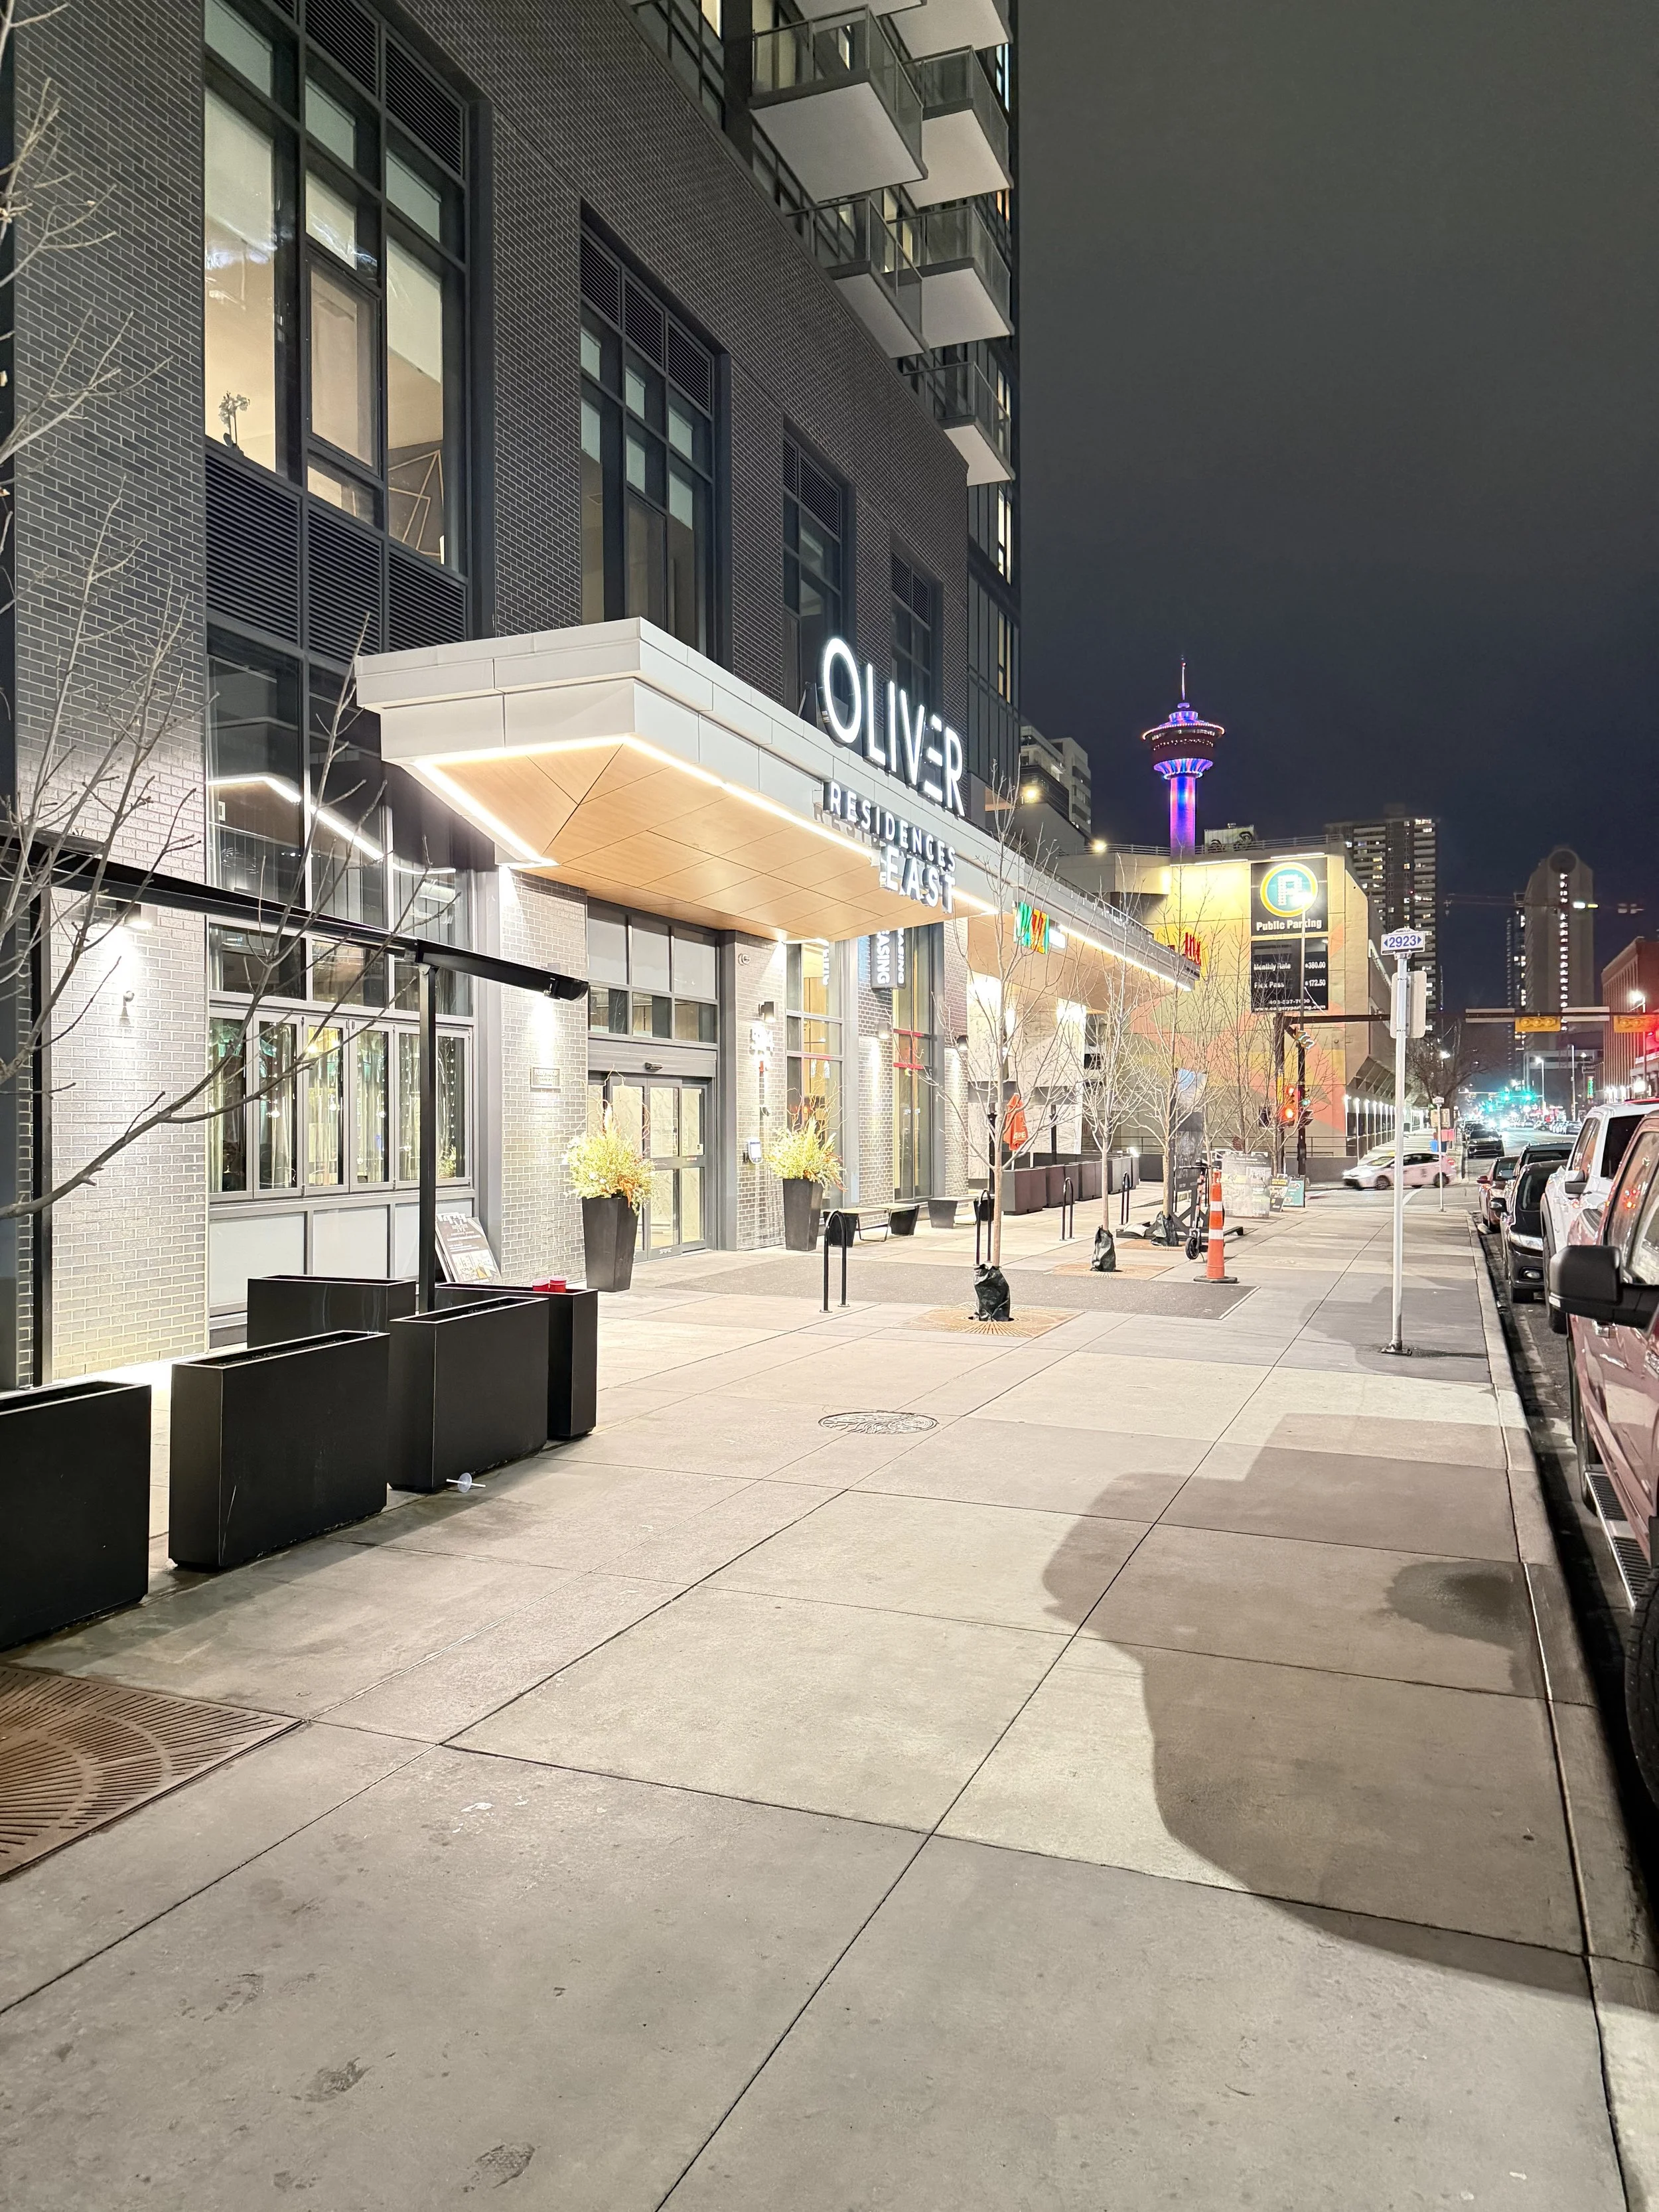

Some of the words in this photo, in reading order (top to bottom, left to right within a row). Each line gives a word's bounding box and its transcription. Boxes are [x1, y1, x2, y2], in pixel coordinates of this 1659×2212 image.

[822, 637, 966, 817] OLIVER
[829, 781, 956, 873] RESIDENCES
[885, 844, 956, 914] EAST
[1256, 921, 1285, 931] Public
[1389, 935, 1416, 948] 2923
